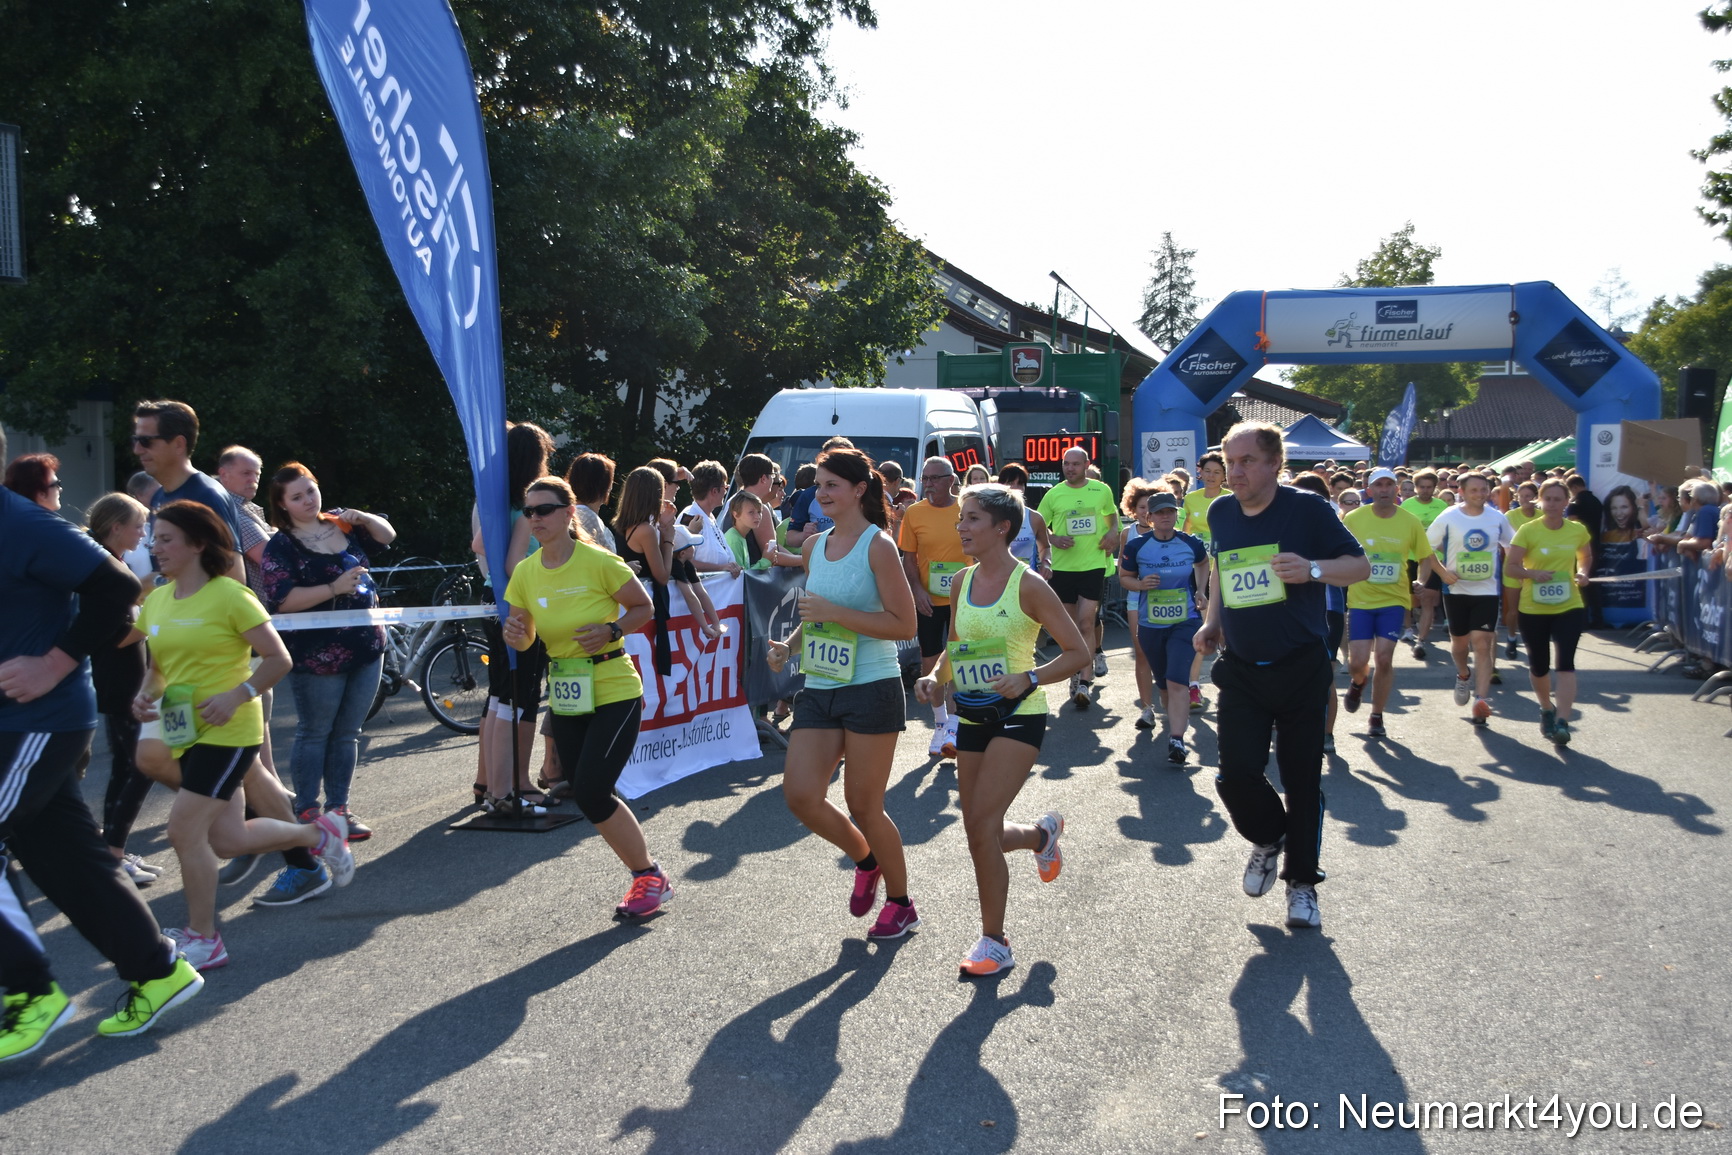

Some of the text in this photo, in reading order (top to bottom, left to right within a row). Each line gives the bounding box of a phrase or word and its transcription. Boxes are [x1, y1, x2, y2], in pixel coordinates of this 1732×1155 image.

[1360, 323, 1453, 341] firmenlauf
[1189, 361, 1237, 371] Fischer
[1071, 518, 1092, 530] 256
[1371, 565, 1394, 576] 678
[1460, 563, 1489, 574] 1489
[1231, 569, 1270, 592] 204
[1539, 585, 1564, 596] 666
[1152, 605, 1183, 618] 6089
[808, 640, 850, 666] 1105
[957, 662, 1004, 685] 1106
[554, 681, 581, 699] 639
[164, 710, 187, 732] 634
